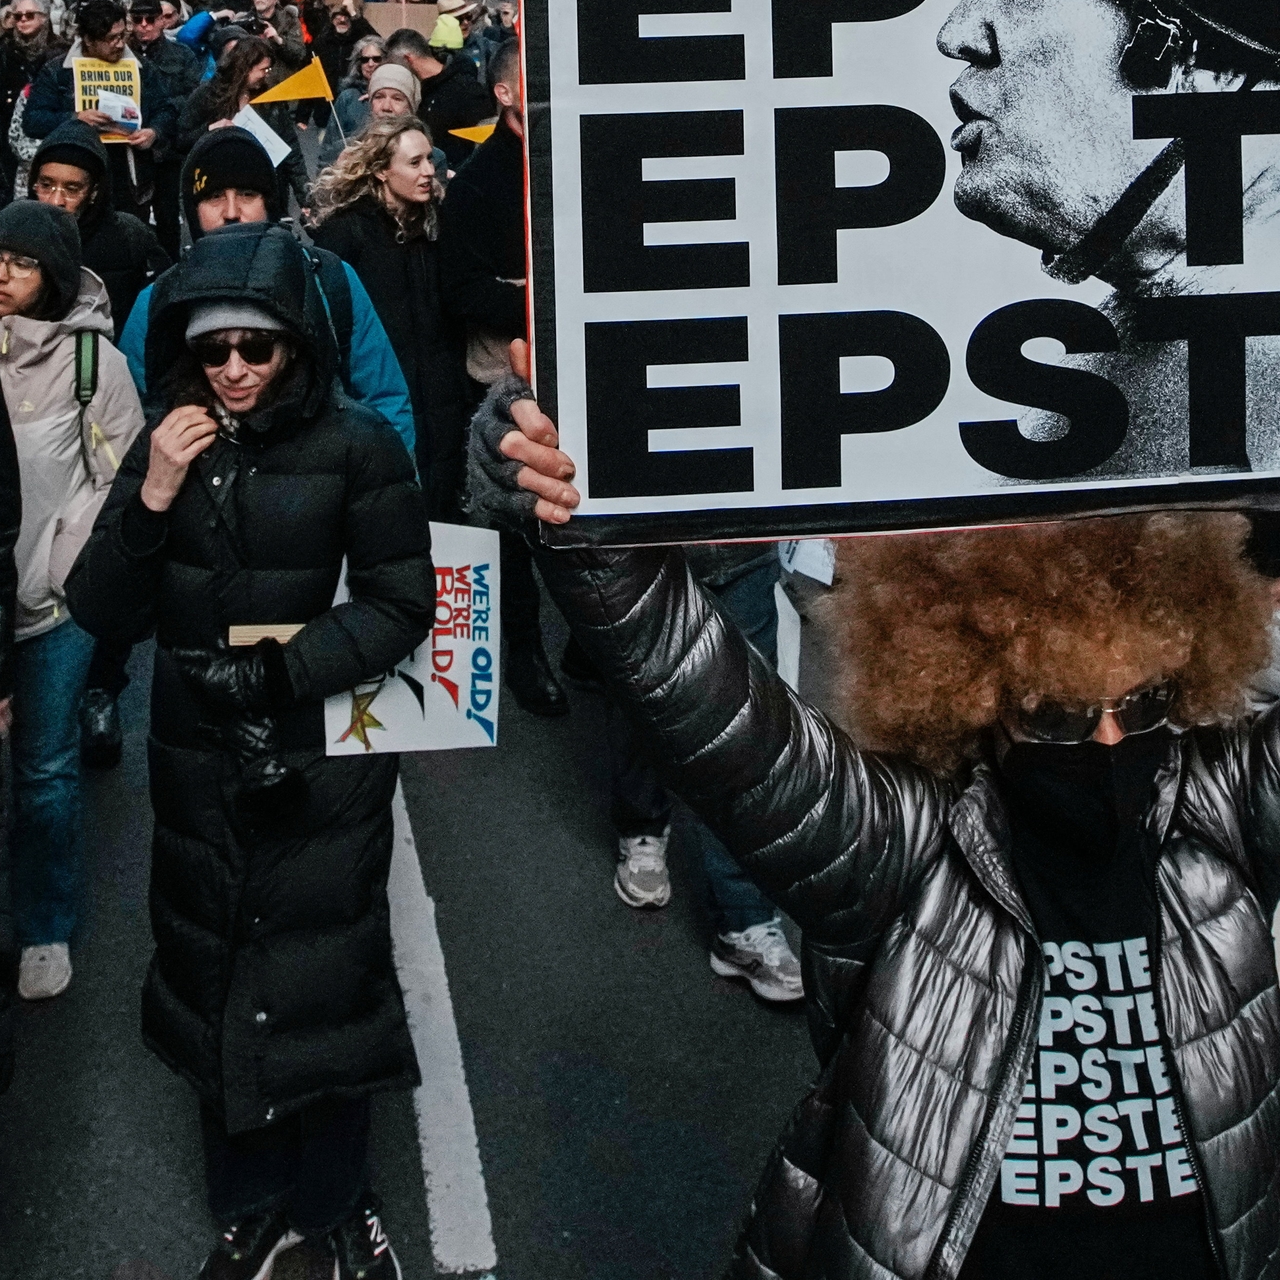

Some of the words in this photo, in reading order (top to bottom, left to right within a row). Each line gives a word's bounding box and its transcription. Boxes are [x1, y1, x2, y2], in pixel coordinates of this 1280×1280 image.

[80, 70, 110, 82] BRING
[114, 70, 133, 82] OUR
[430, 565, 459, 711] BOLD!
[466, 646, 495, 745] OLD!
[1001, 1147, 1199, 1207] EPSTE
